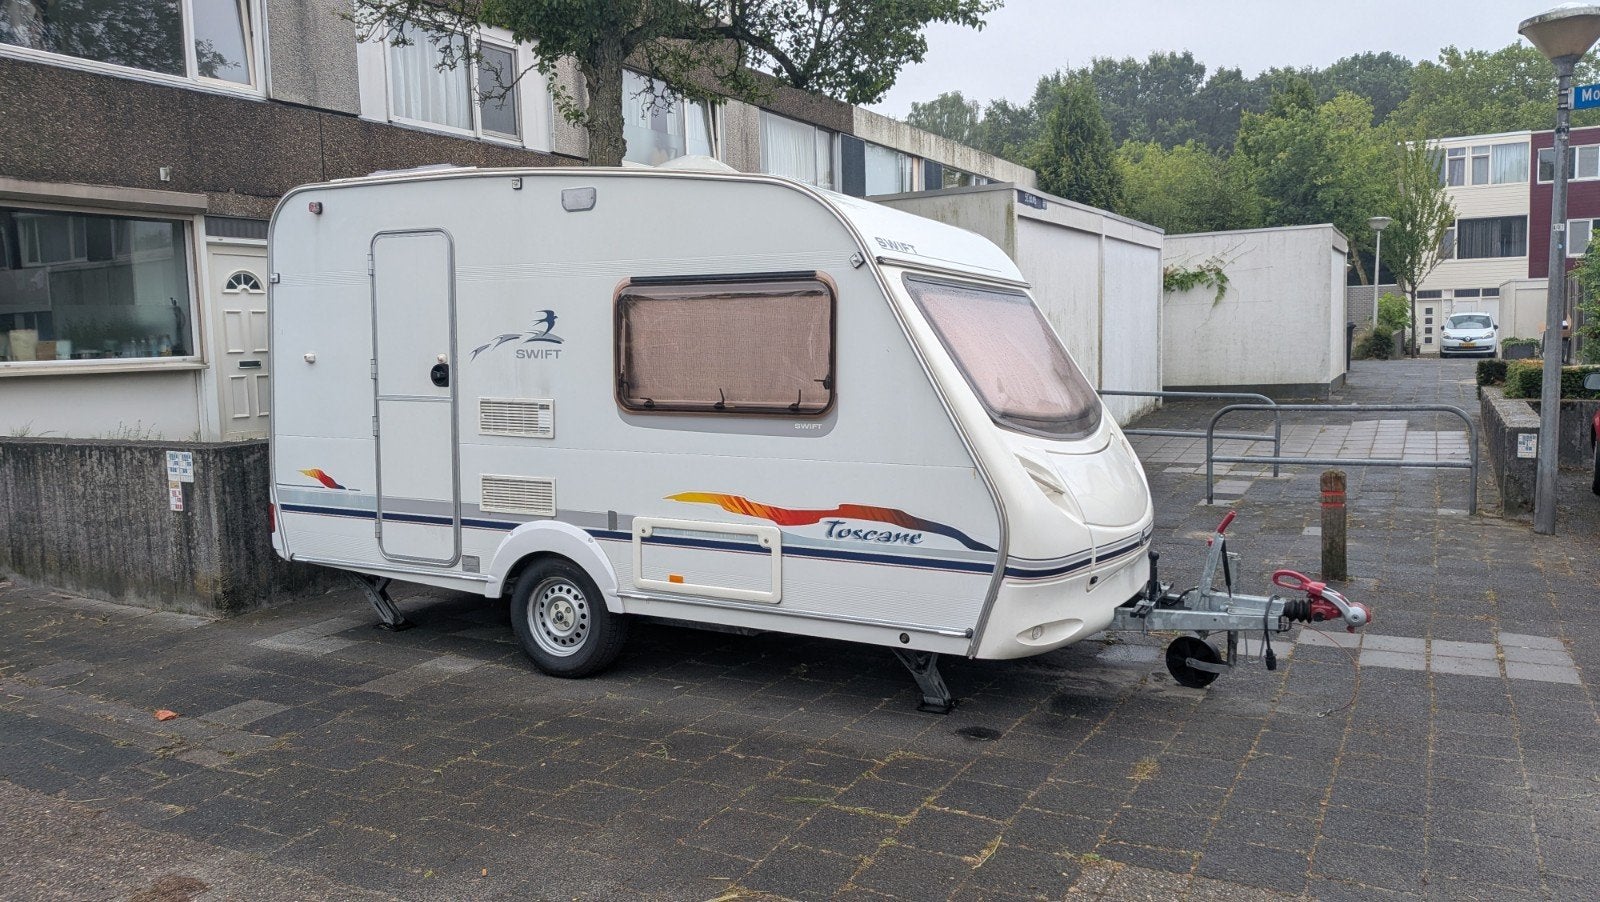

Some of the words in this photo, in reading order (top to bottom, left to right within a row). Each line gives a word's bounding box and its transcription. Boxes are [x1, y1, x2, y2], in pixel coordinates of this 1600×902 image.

[874, 236, 917, 254] SWIFT
[515, 349, 562, 359] SWIFT
[825, 520, 923, 544] Toscane
